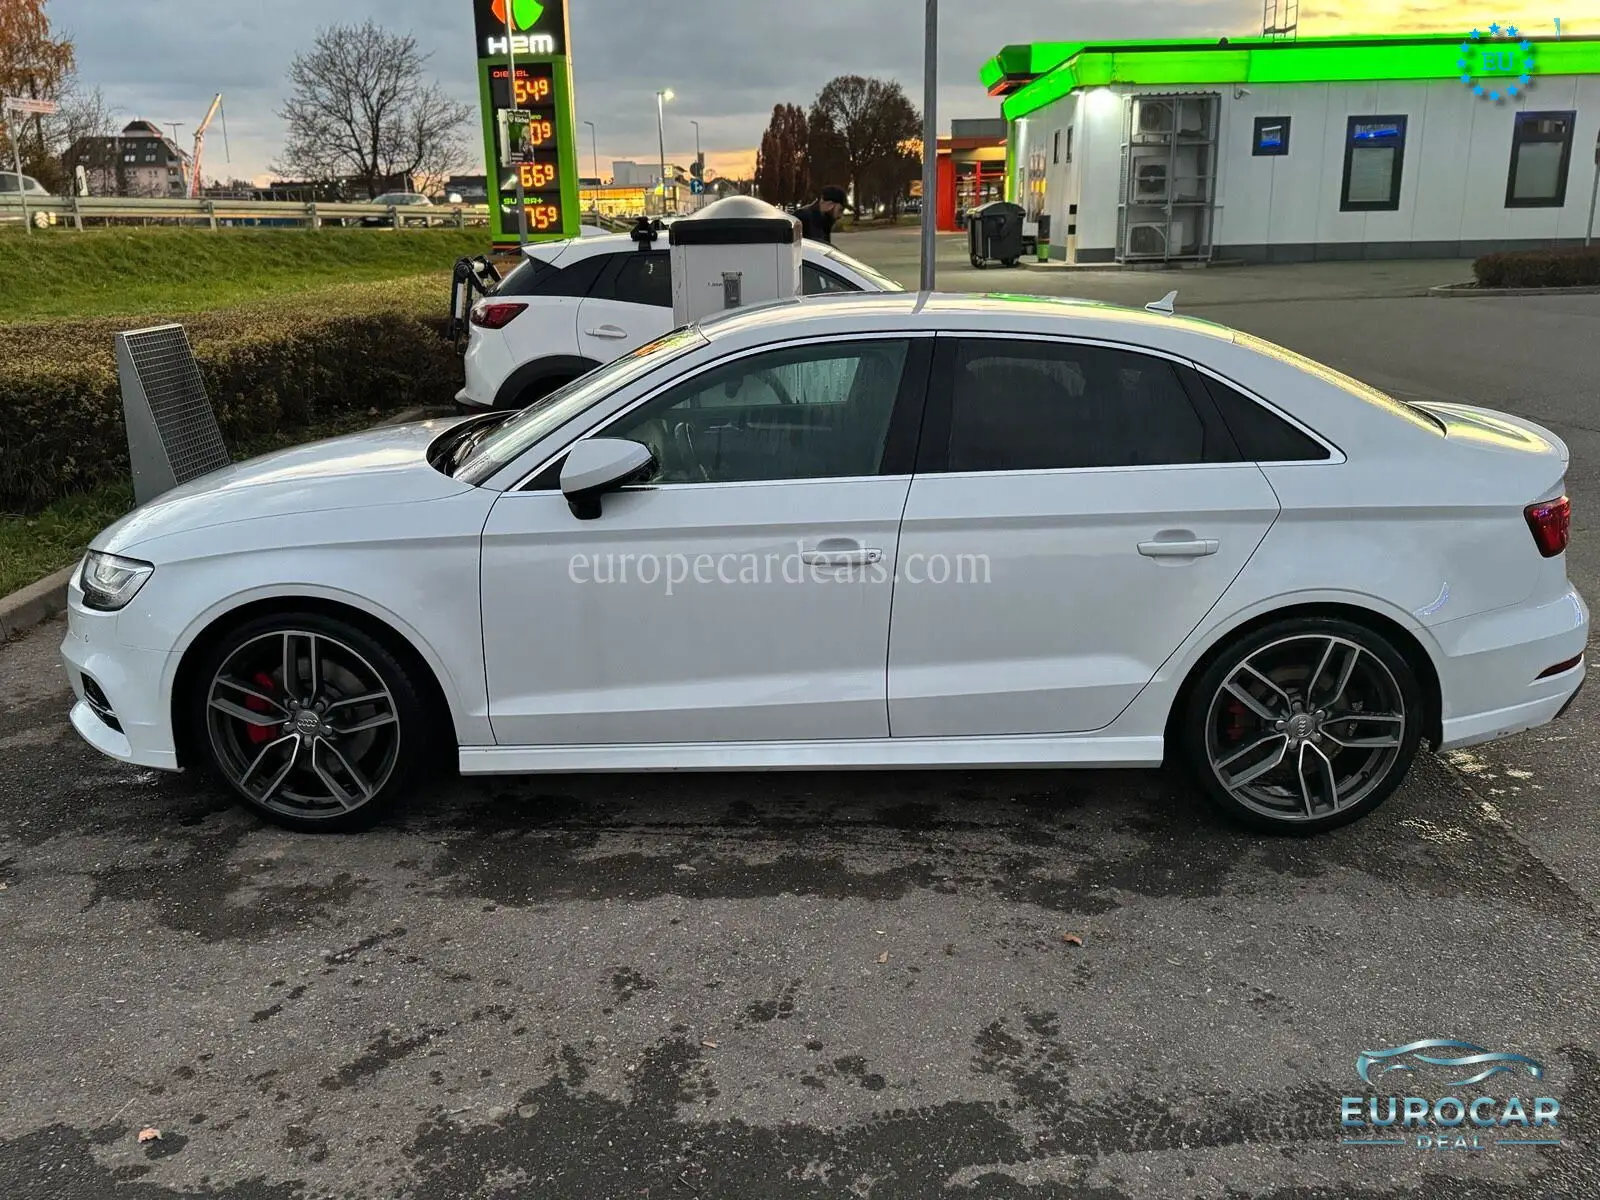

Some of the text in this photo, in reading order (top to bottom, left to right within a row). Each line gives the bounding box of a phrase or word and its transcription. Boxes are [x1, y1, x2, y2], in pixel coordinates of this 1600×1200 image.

[493, 70, 529, 78] DIEEL
[520, 164, 554, 188] 669
[503, 197, 543, 205] SUER+
[524, 206, 557, 229] 759
